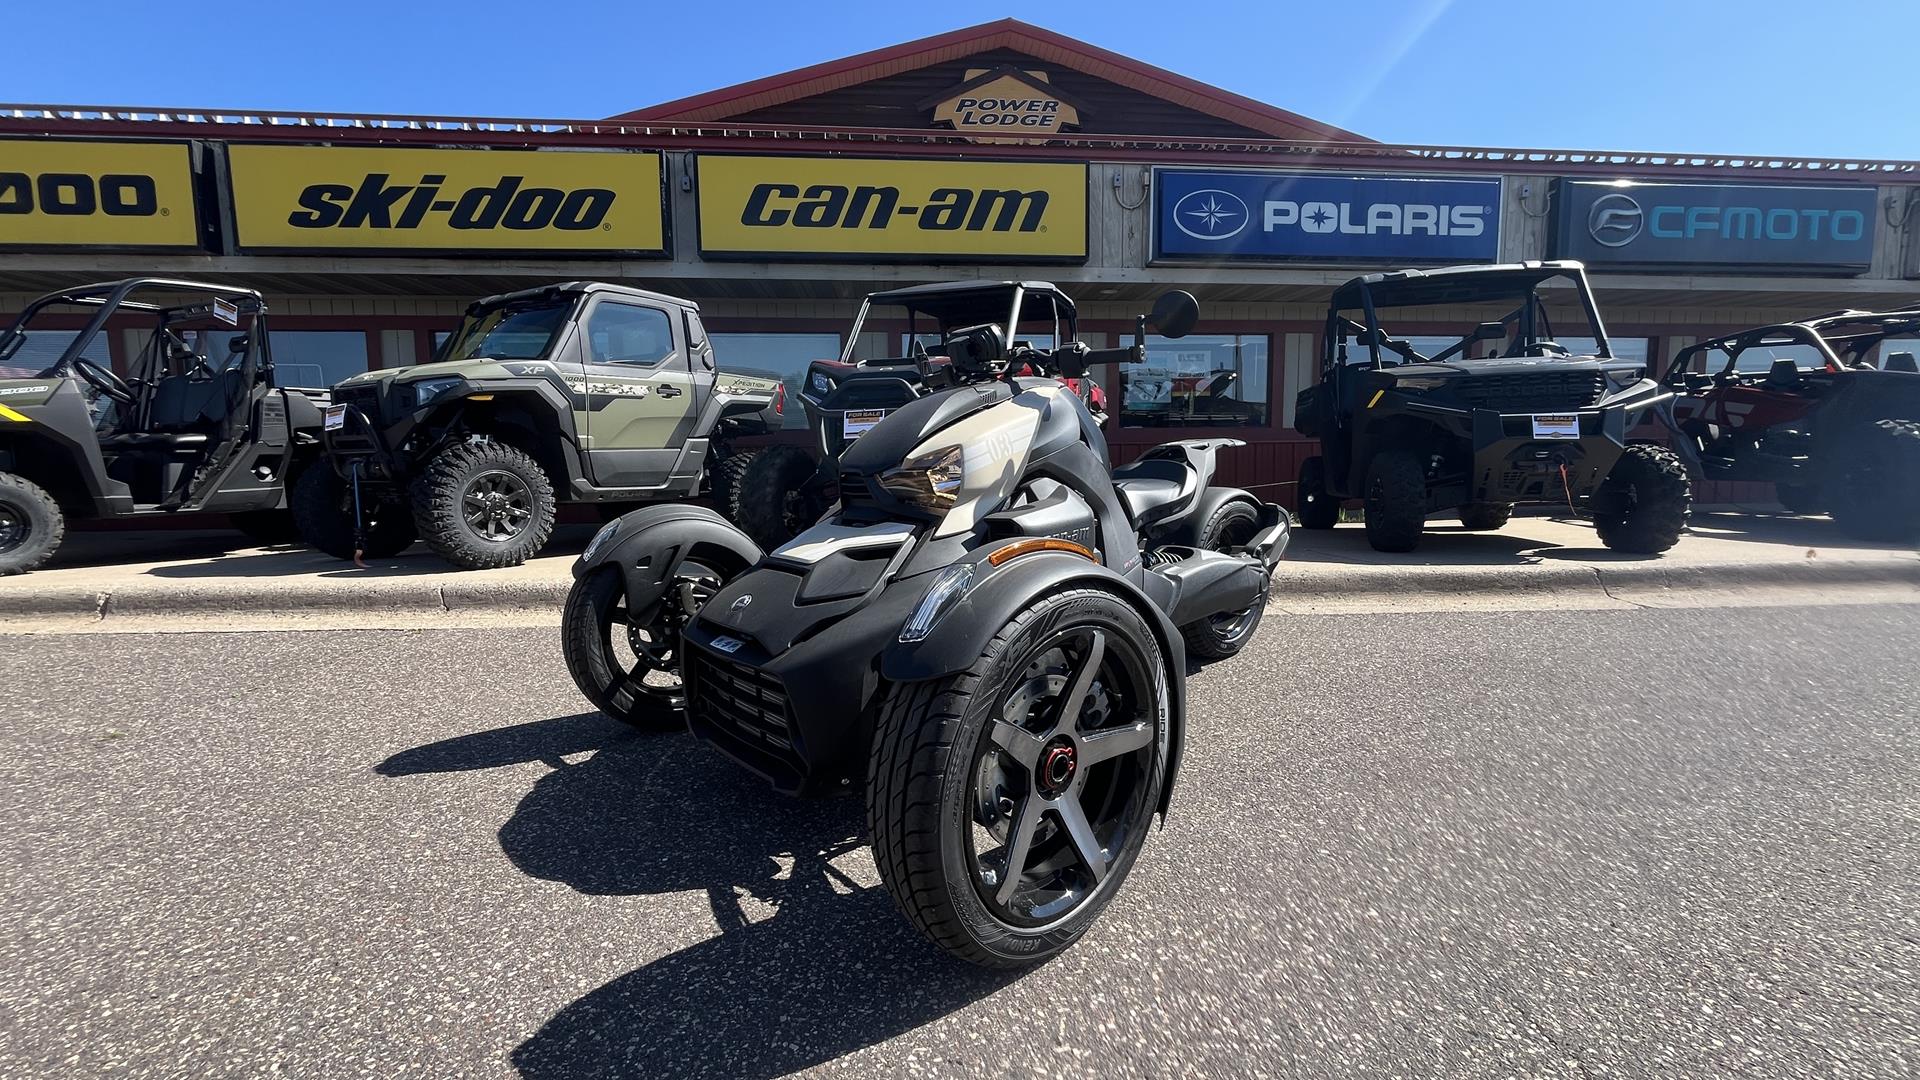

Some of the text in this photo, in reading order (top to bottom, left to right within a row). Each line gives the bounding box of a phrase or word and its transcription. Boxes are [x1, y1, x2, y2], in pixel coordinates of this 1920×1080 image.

[956, 99, 1060, 113] POWER
[961, 112, 1056, 127] LODGE
[287, 173, 616, 231] ski-doo
[741, 183, 1050, 232] can-am
[1263, 200, 1485, 237] POLARIS
[1651, 205, 1864, 241] CFMOTO
[521, 366, 546, 375] XP
